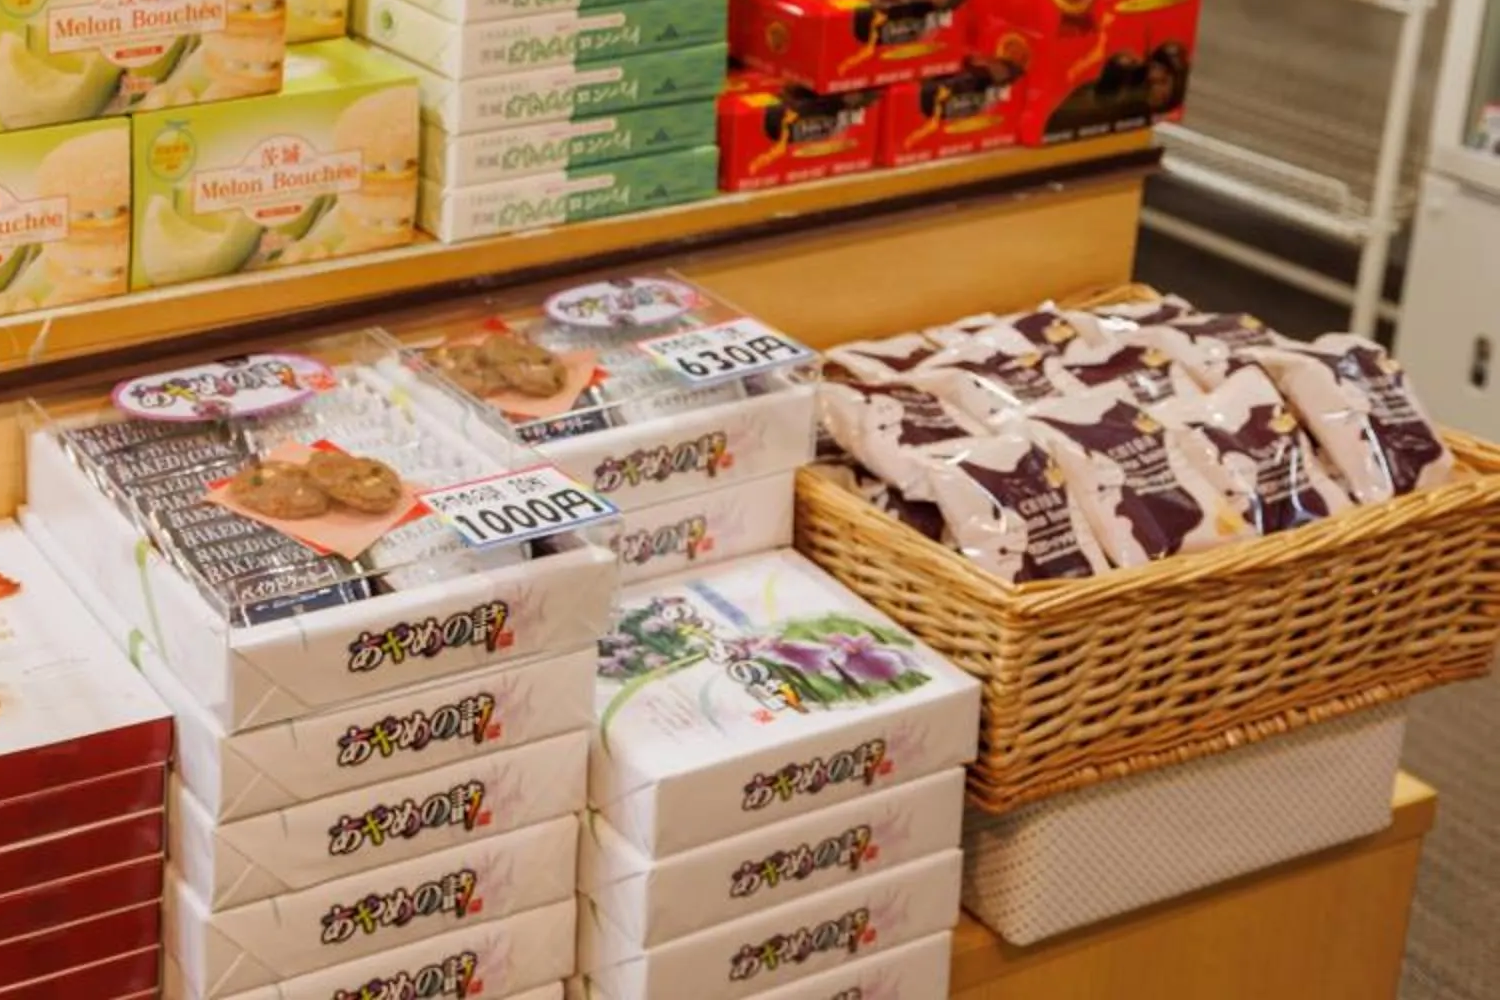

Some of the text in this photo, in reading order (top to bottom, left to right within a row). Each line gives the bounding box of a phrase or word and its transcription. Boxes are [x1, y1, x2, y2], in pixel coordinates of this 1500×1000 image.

[55, 13, 121, 39] Melon
[200, 176, 264, 200] Melon
[678, 333, 800, 377] 630円
[117, 454, 182, 487] BAKED
[594, 430, 728, 493] あやめの詩
[181, 520, 245, 548] BAKED
[455, 487, 601, 542] 1000円
[348, 600, 509, 673] あやめの詩
[337, 692, 496, 767] あやめの詩
[741, 737, 887, 812] あやめの詩
[327, 779, 485, 857] あやめの詩
[729, 824, 873, 899] あやめの詩
[320, 868, 478, 946] あやめの詩
[729, 906, 871, 982] あやめの詩
